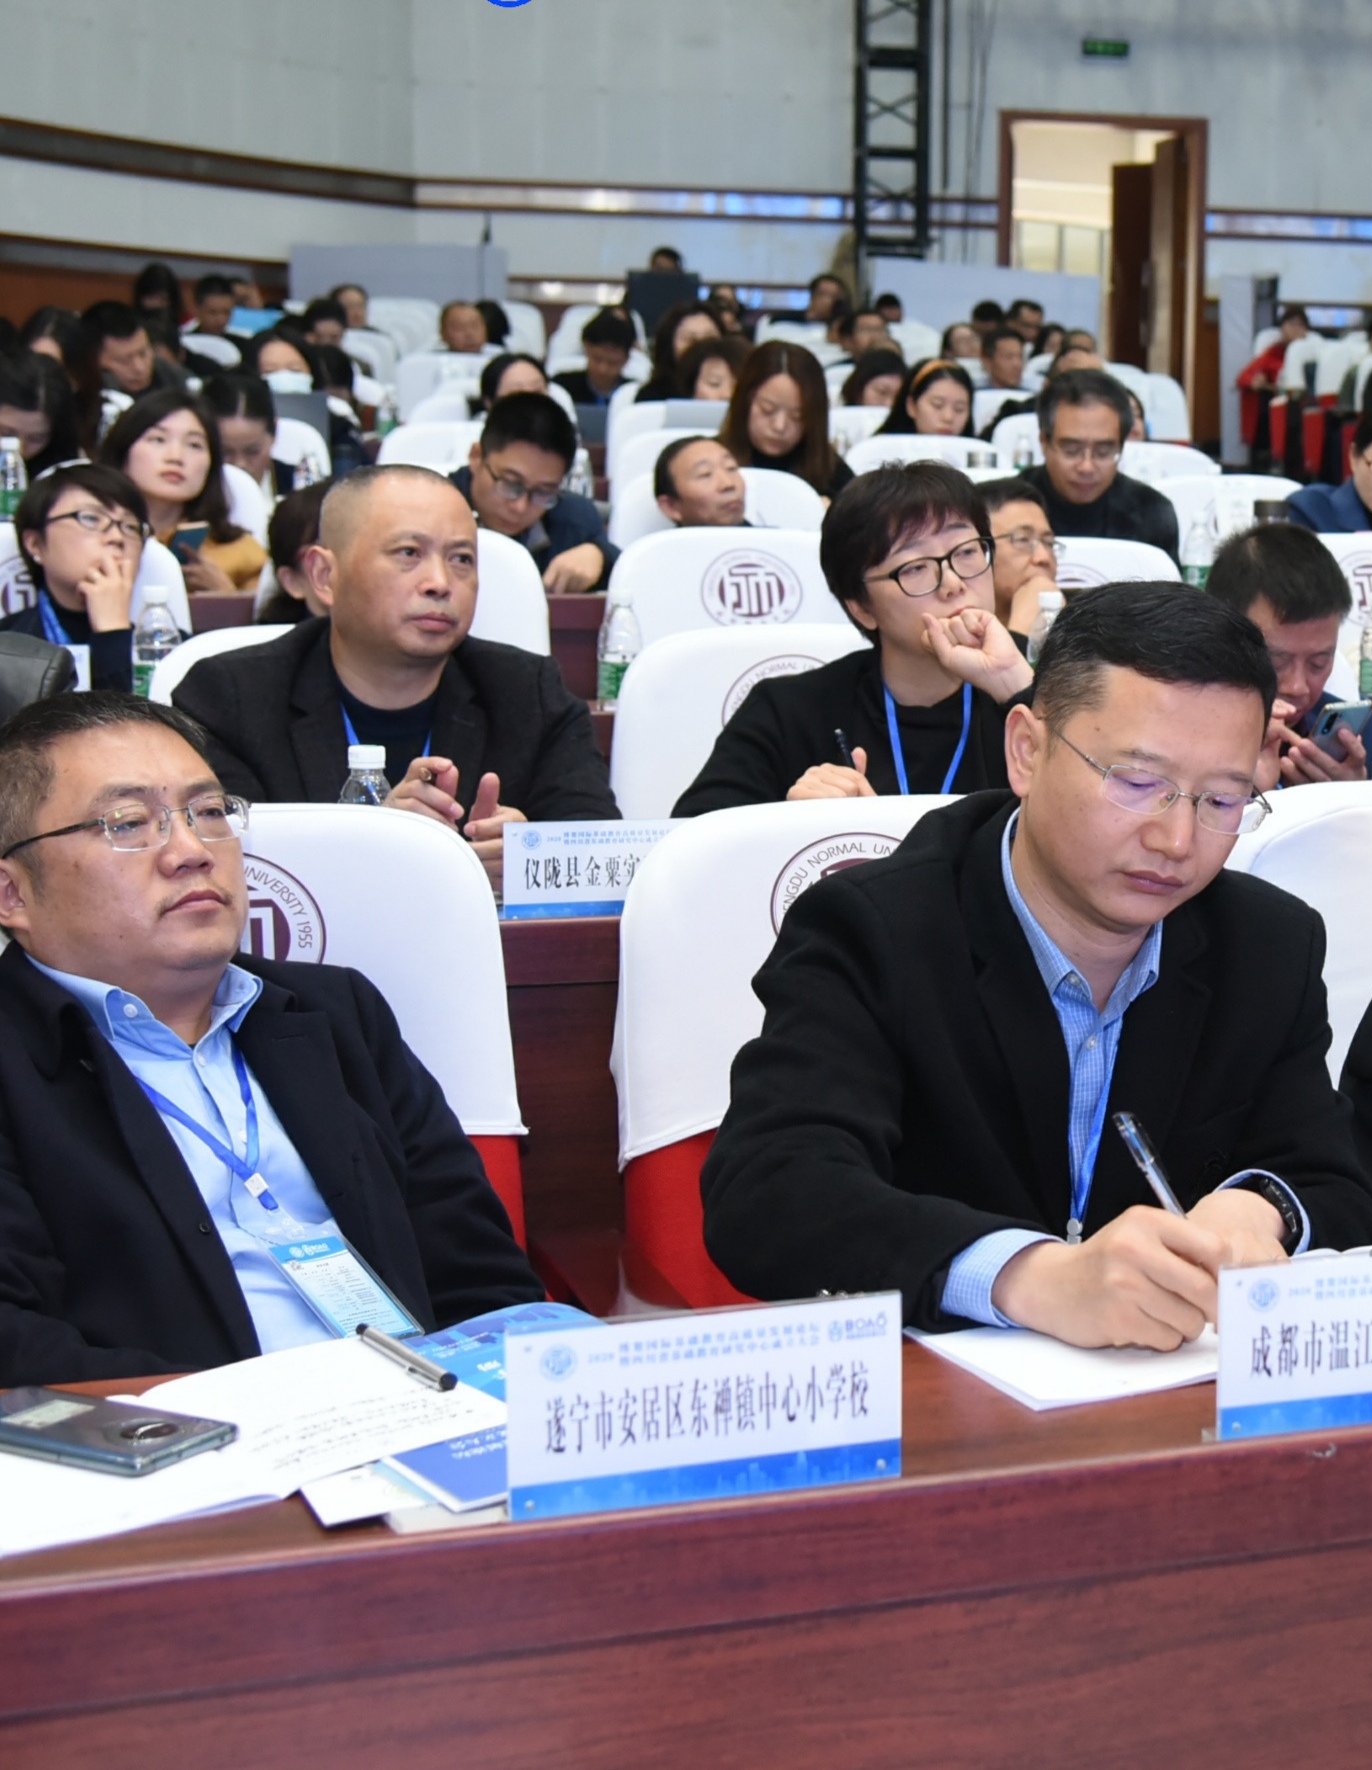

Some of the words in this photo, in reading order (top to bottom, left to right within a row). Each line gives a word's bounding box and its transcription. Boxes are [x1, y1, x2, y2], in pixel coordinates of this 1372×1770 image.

[807, 842, 867, 869] NORMAL
[524, 853, 646, 891] 仪陇县金粟实
[297, 920, 313, 949] 1955
[844, 1314, 888, 1332] BOAO
[545, 1361, 869, 1454] 遂宁市安居区东禅镇中心小学校
